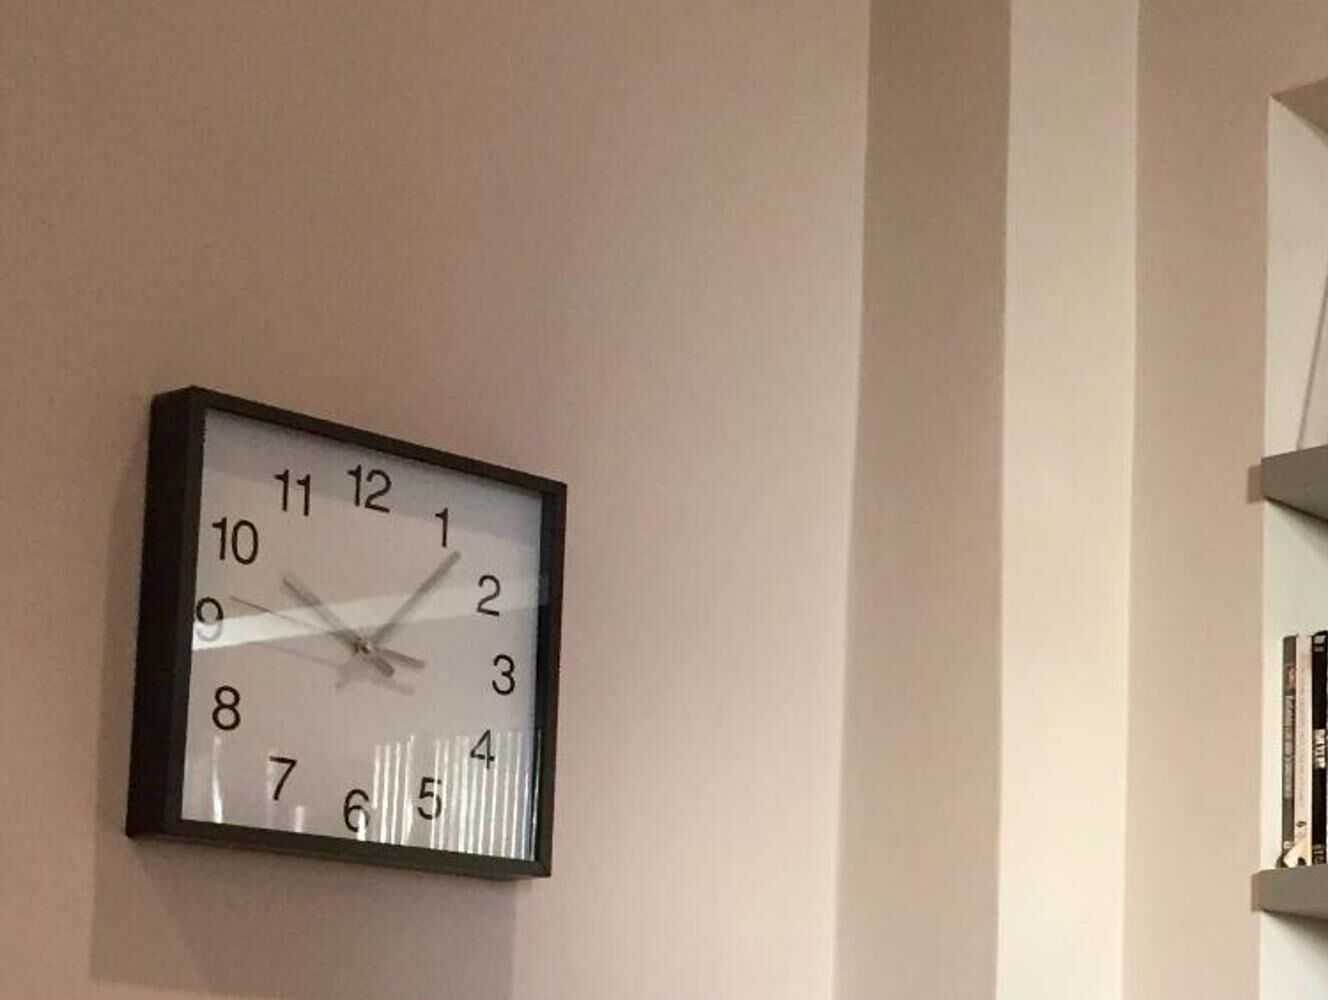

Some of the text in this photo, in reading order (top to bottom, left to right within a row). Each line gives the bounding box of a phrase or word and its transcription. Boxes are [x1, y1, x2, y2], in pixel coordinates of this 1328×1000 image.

[275, 468, 311, 516] 11
[347, 464, 392, 513] 12
[211, 516, 259, 564] 10
[434, 507, 451, 548] 1
[476, 574, 501, 616] 2
[195, 596, 224, 642] 9
[491, 654, 516, 696] 3
[212, 685, 241, 731] 8
[469, 729, 496, 768] 4
[268, 756, 298, 801] 7
[417, 776, 443, 821] 5
[343, 788, 370, 834] 6
